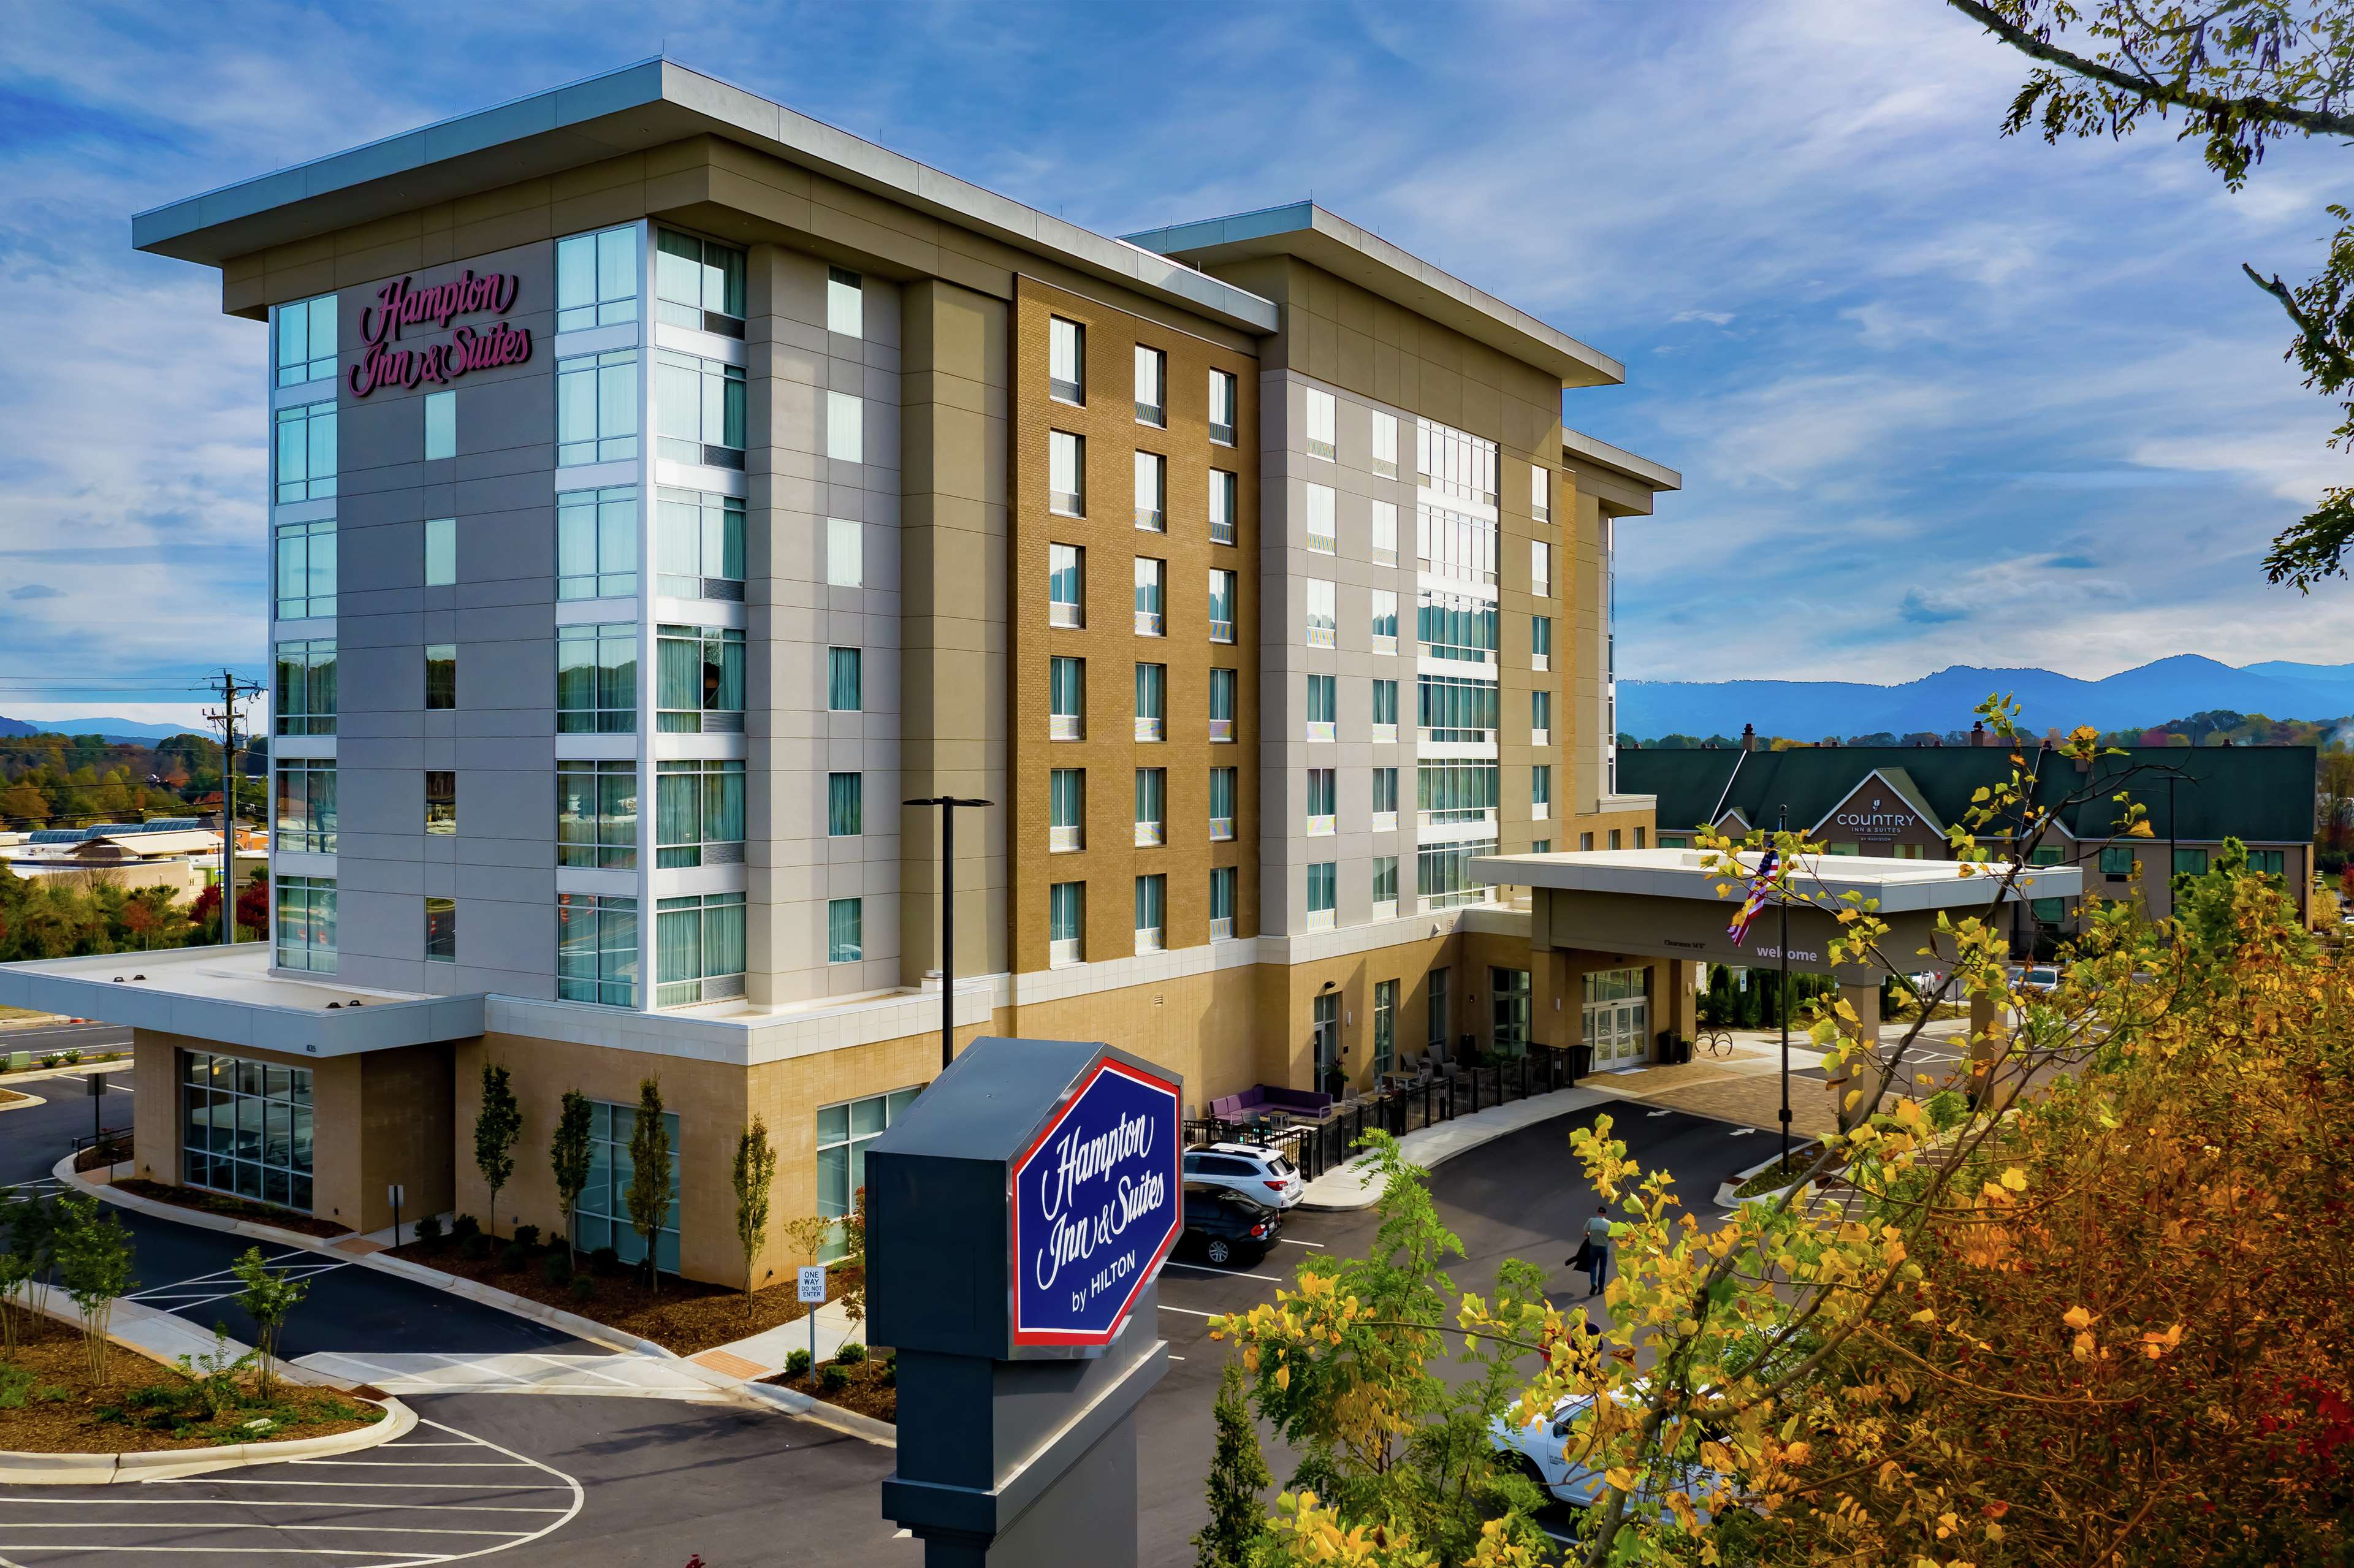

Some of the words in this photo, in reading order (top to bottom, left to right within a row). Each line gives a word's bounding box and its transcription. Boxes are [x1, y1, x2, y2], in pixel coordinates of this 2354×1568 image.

[359, 270, 519, 346] Hampton
[348, 341, 424, 397] Inn
[421, 344, 449, 384] &
[441, 322, 533, 376] Suites
[1756, 946, 1818, 961] welome
[1042, 1111, 1154, 1220] Hampton
[1037, 1212, 1097, 1290] Inn
[1097, 1205, 1112, 1244] &
[1111, 1170, 1164, 1235] Suites
[1072, 1288, 1087, 1312] by
[1091, 1249, 1135, 1298] HILTON
